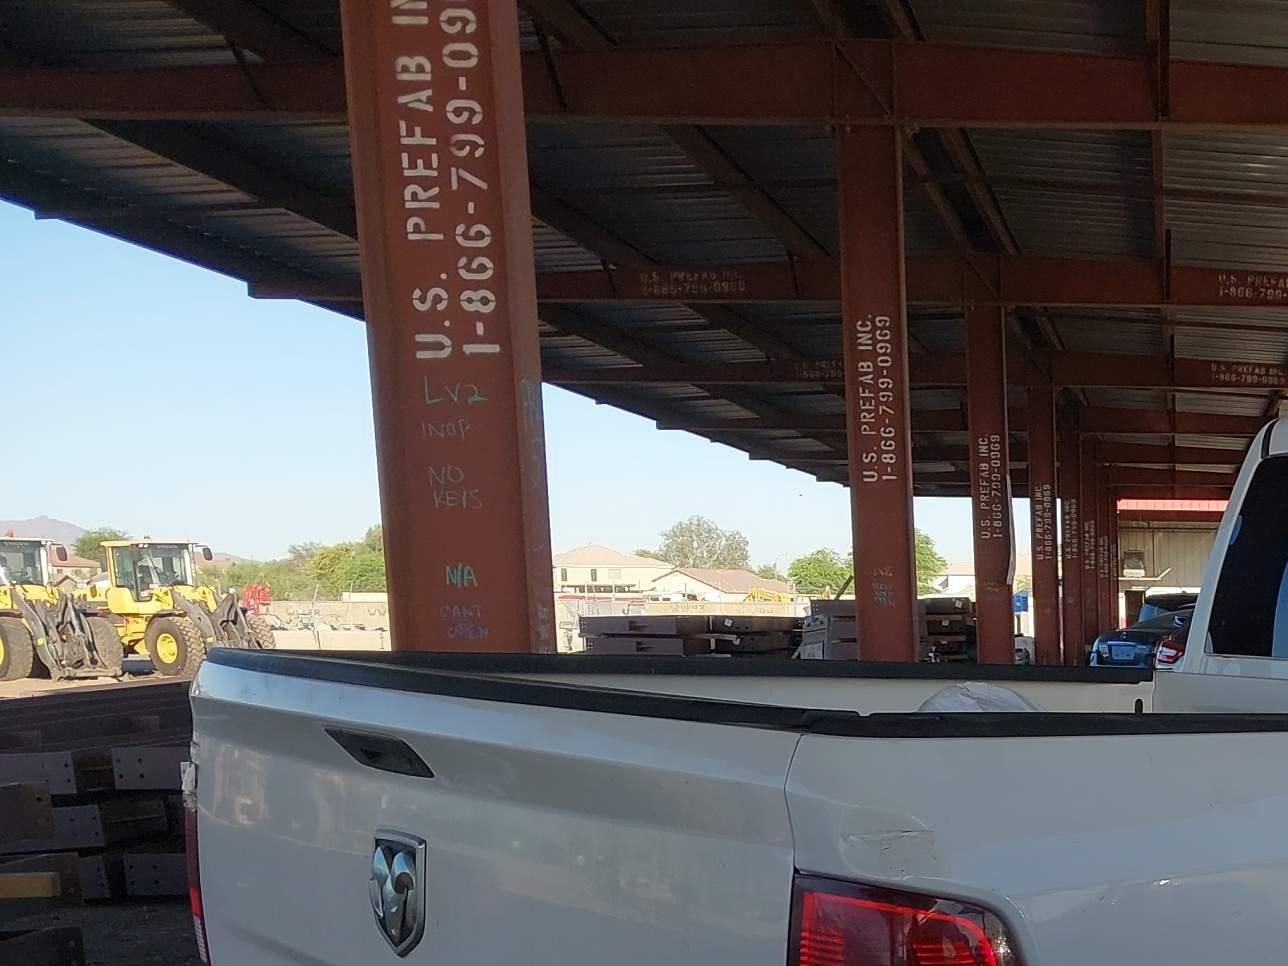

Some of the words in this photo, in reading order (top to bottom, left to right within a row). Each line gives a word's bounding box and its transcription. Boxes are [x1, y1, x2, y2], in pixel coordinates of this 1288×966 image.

[396, 55, 444, 240] PREFAB
[412, 272, 452, 359] U.S.
[856, 314, 874, 351] INC.
[858, 361, 877, 435] PREFAB
[875, 315, 898, 481] 1-866-799-0969
[428, 465, 465, 486] NO
[862, 446, 879, 482] U.S.
[979, 463, 990, 509] PREFAB
